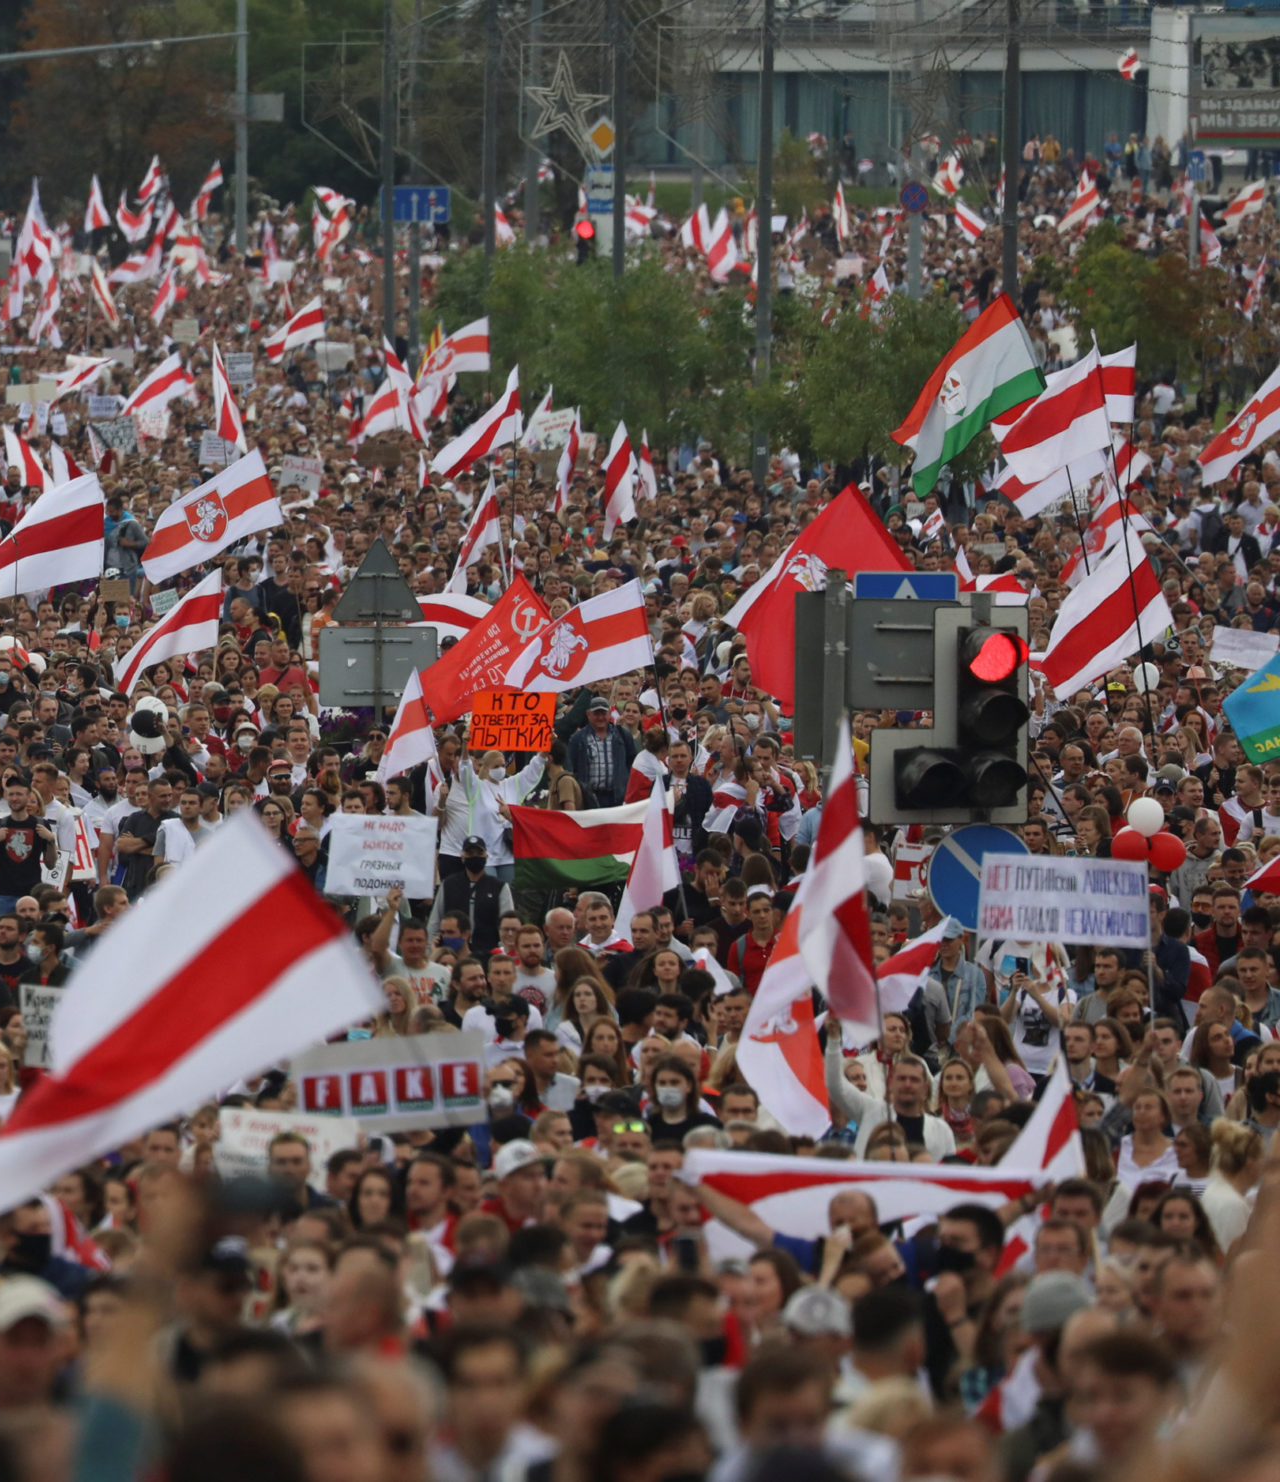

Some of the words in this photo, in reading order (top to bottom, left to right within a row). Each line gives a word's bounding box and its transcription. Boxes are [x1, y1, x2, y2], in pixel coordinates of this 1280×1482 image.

[1200, 114, 1232, 128] МЫ
[472, 714, 528, 726] ОТВЕТИТ
[532, 714, 549, 726] ЗА
[472, 725, 552, 748] ПЫТКИ?
[363, 821, 376, 831] НЕ
[378, 821, 406, 832] НАДО
[672, 827, 693, 839] ULE
[362, 840, 404, 851] БОЯТЬСЯ
[360, 860, 403, 871] ГРЯЗНЫХ
[354, 878, 406, 889] ПОДОНКОВ
[315, 1065, 468, 1109] FAKE
